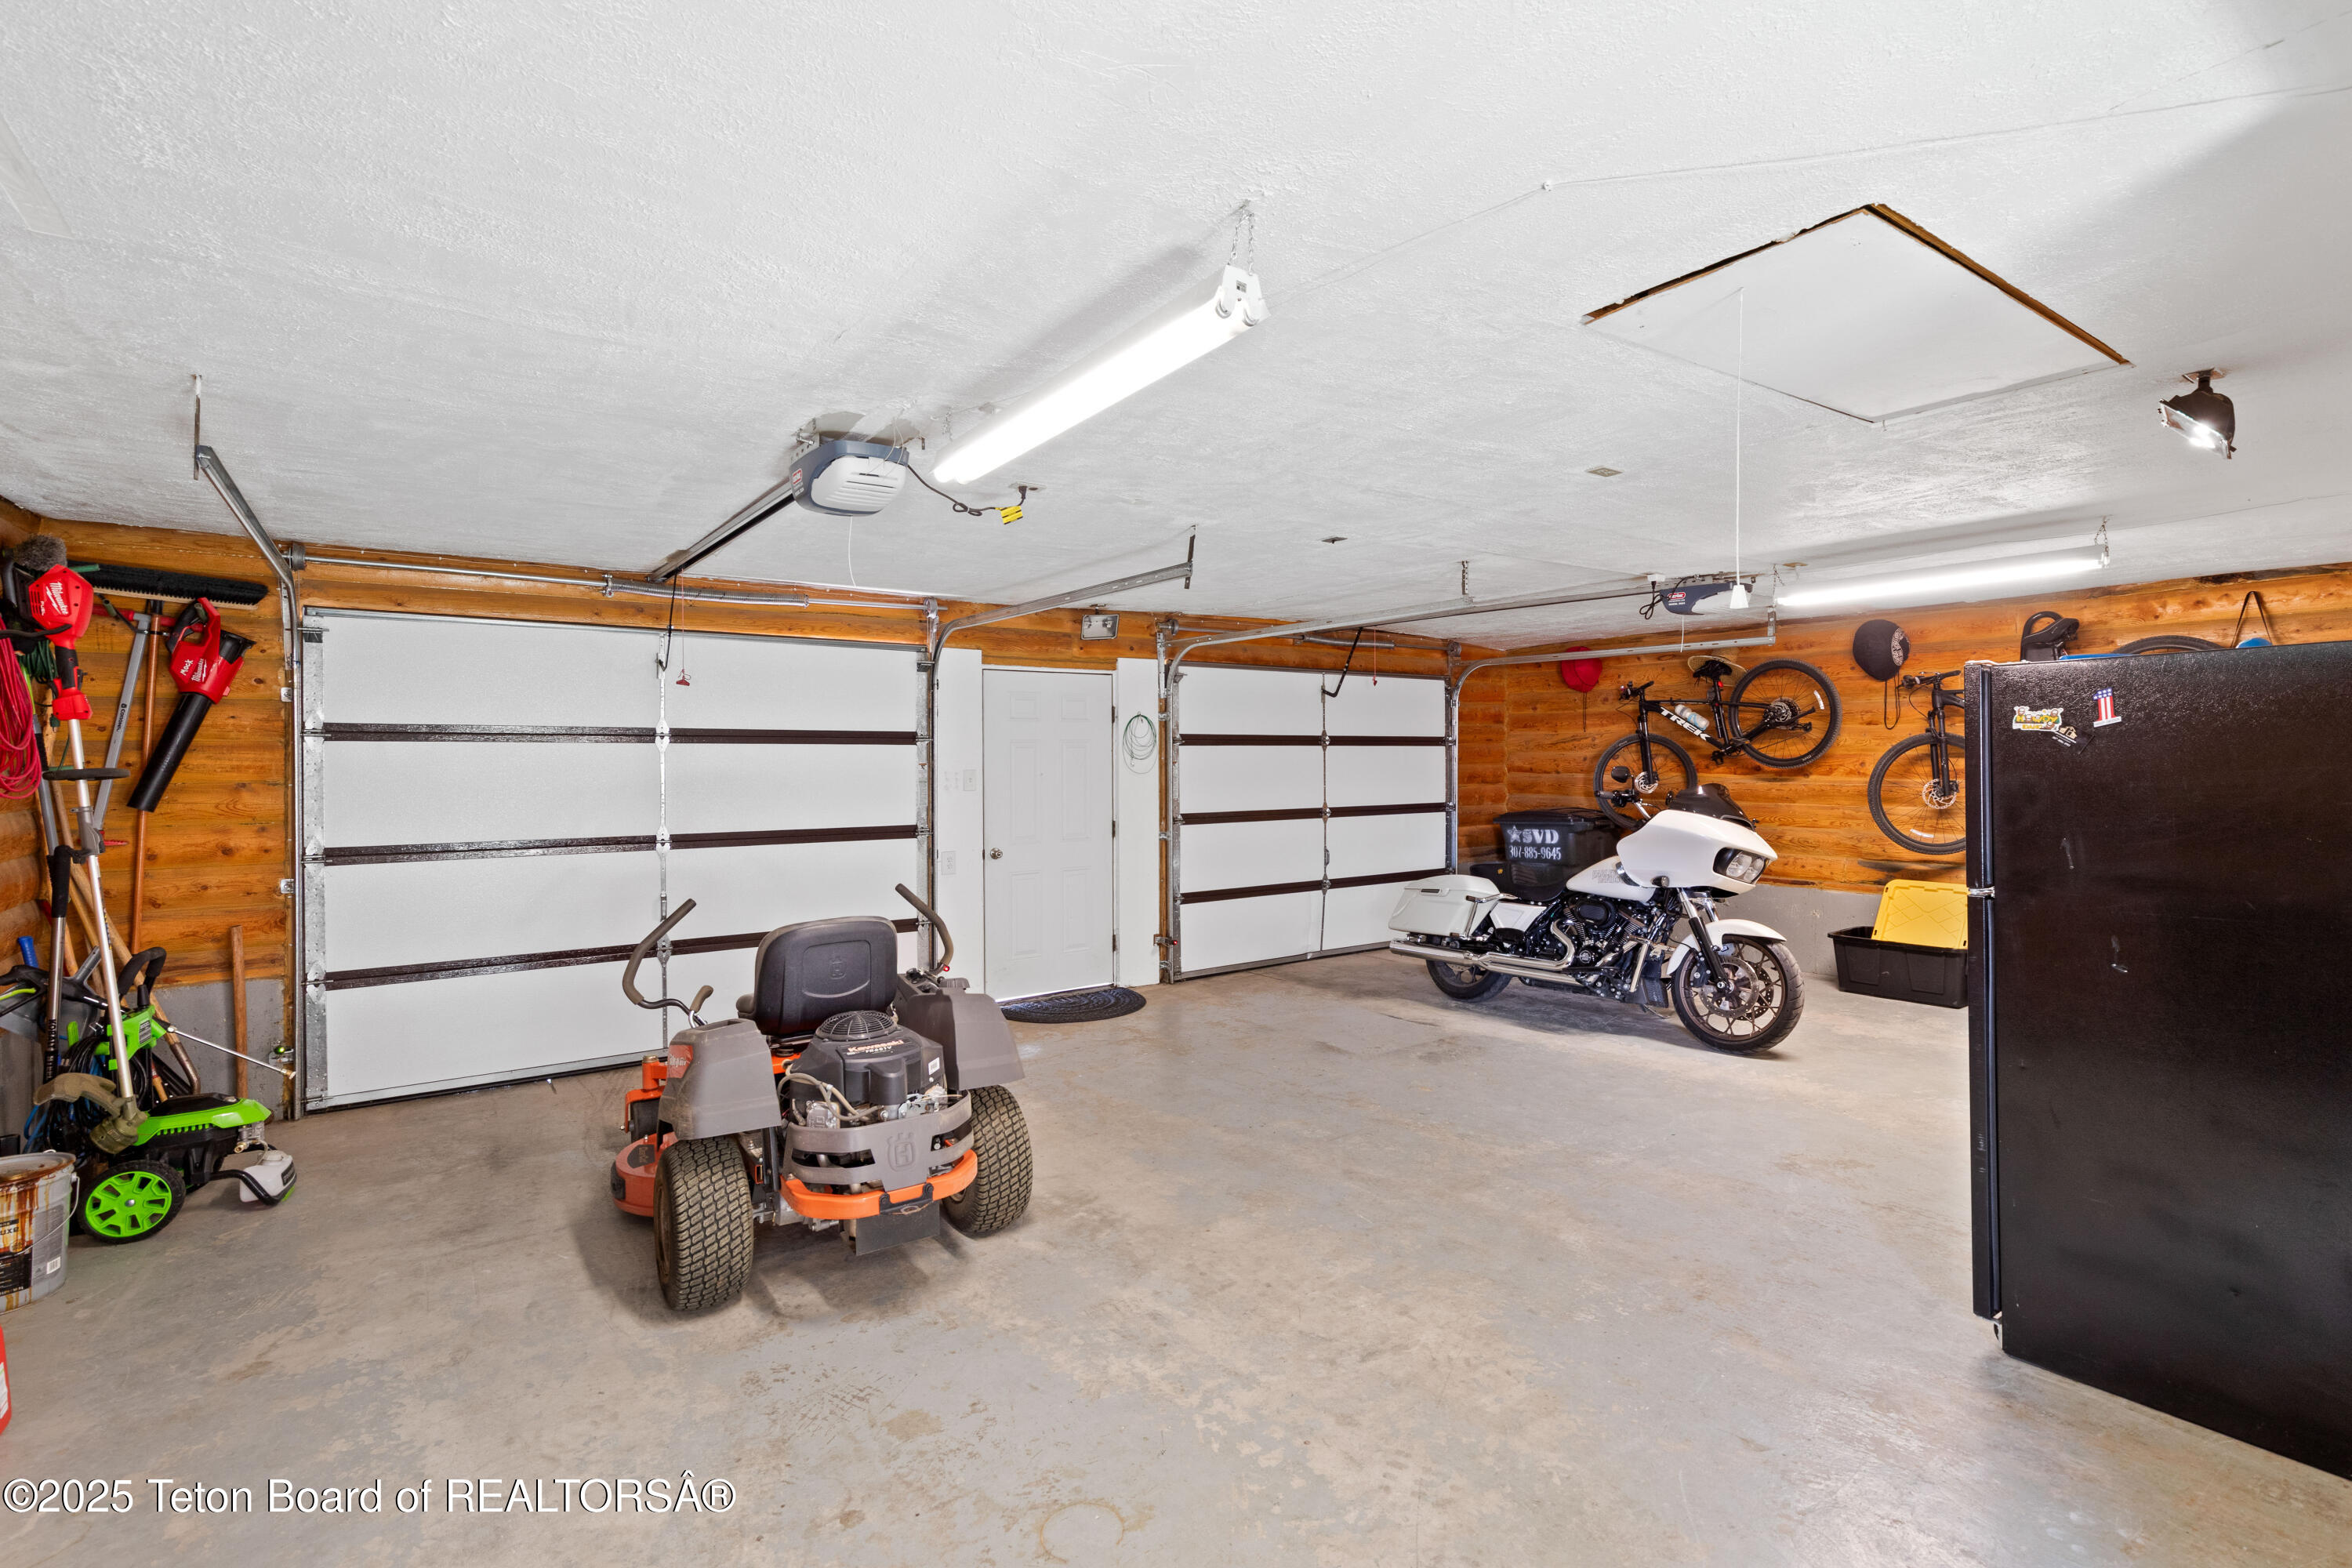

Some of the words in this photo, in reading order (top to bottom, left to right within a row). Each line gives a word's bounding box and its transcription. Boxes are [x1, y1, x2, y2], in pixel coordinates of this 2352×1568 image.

[49, 581, 69, 615] Milwaukee
[191, 658, 204, 682] Milwaukee
[1661, 706, 1711, 741] TREK
[1523, 829, 1559, 844] SVD
[1508, 845, 1562, 860] 307-885-9645
